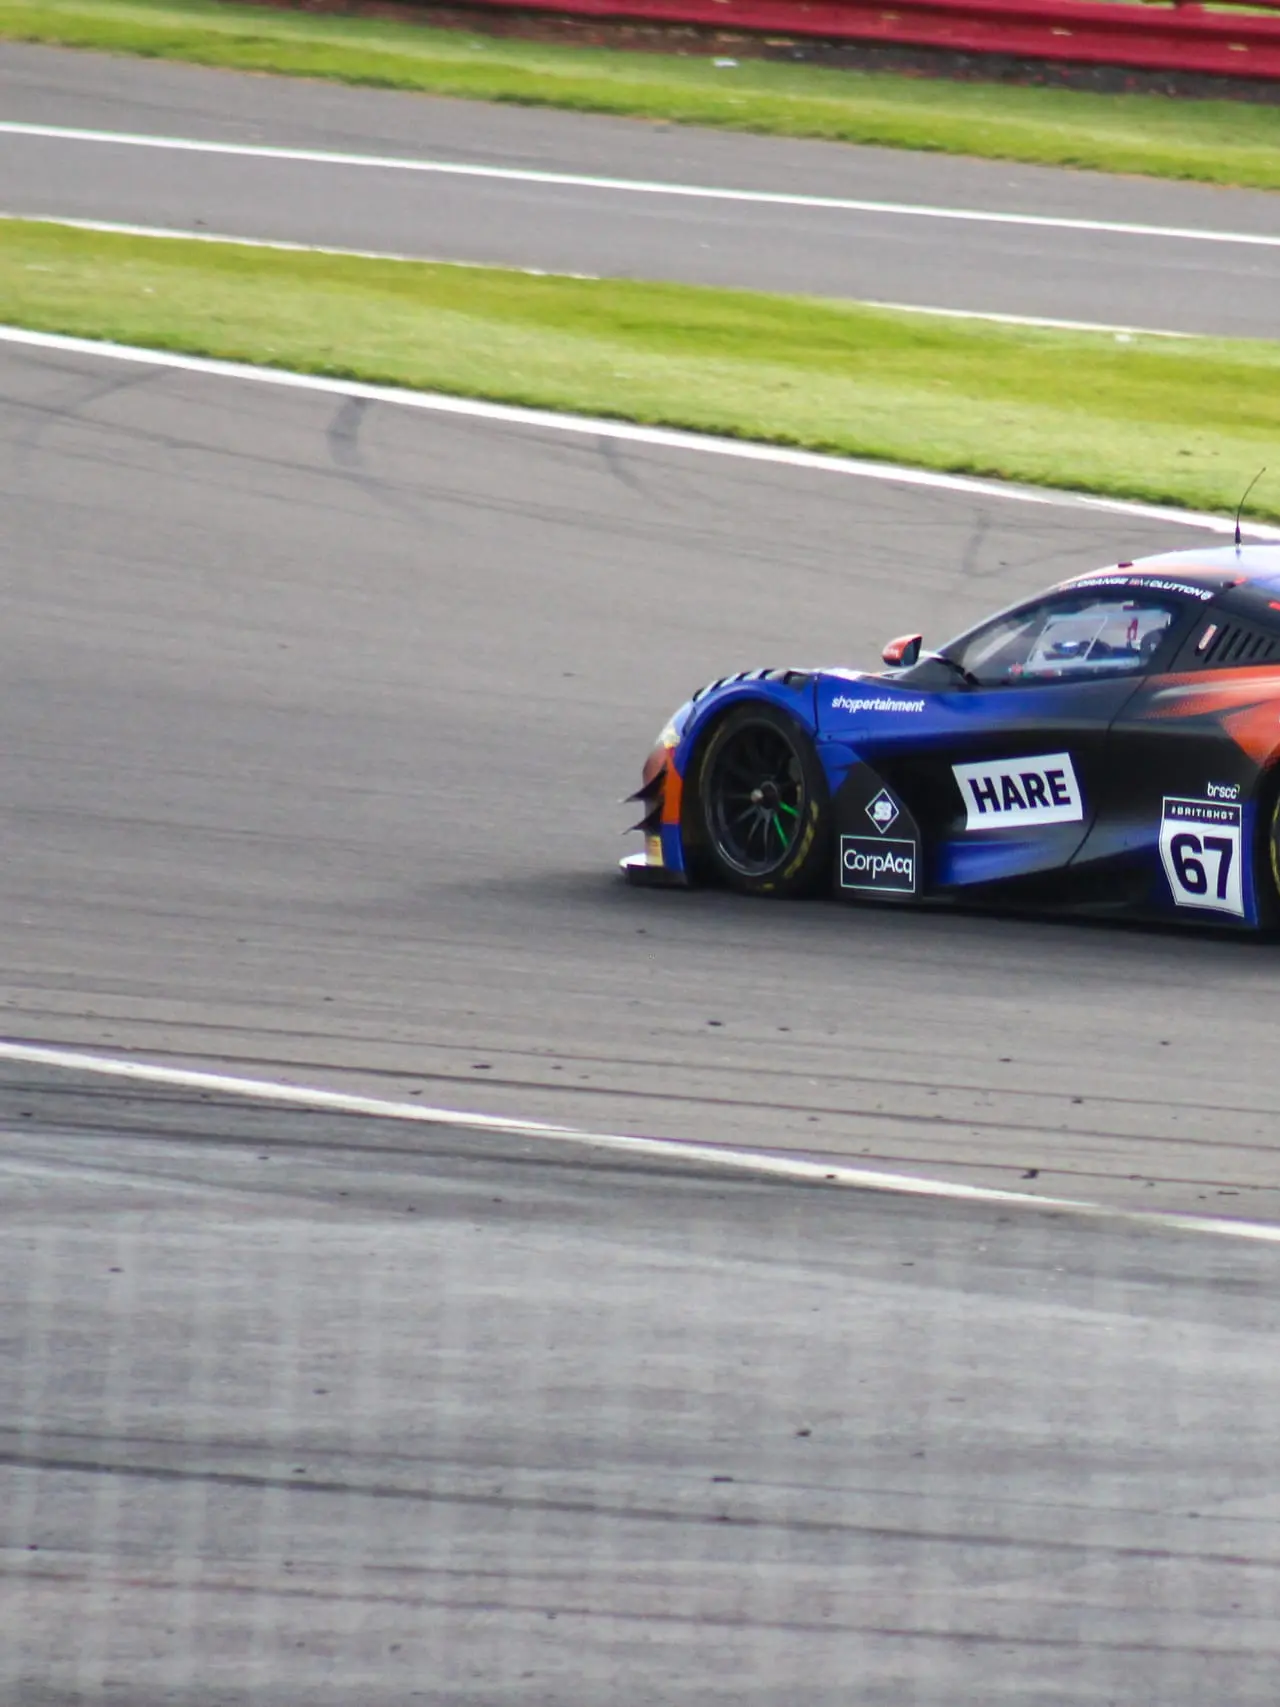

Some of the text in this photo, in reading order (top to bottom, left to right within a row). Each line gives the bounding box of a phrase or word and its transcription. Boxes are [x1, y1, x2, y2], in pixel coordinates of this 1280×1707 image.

[967, 769, 1072, 815] HARE
[1207, 782, 1239, 799] brscc
[843, 849, 913, 882] CorpAcq
[1170, 833, 1233, 901] 67
